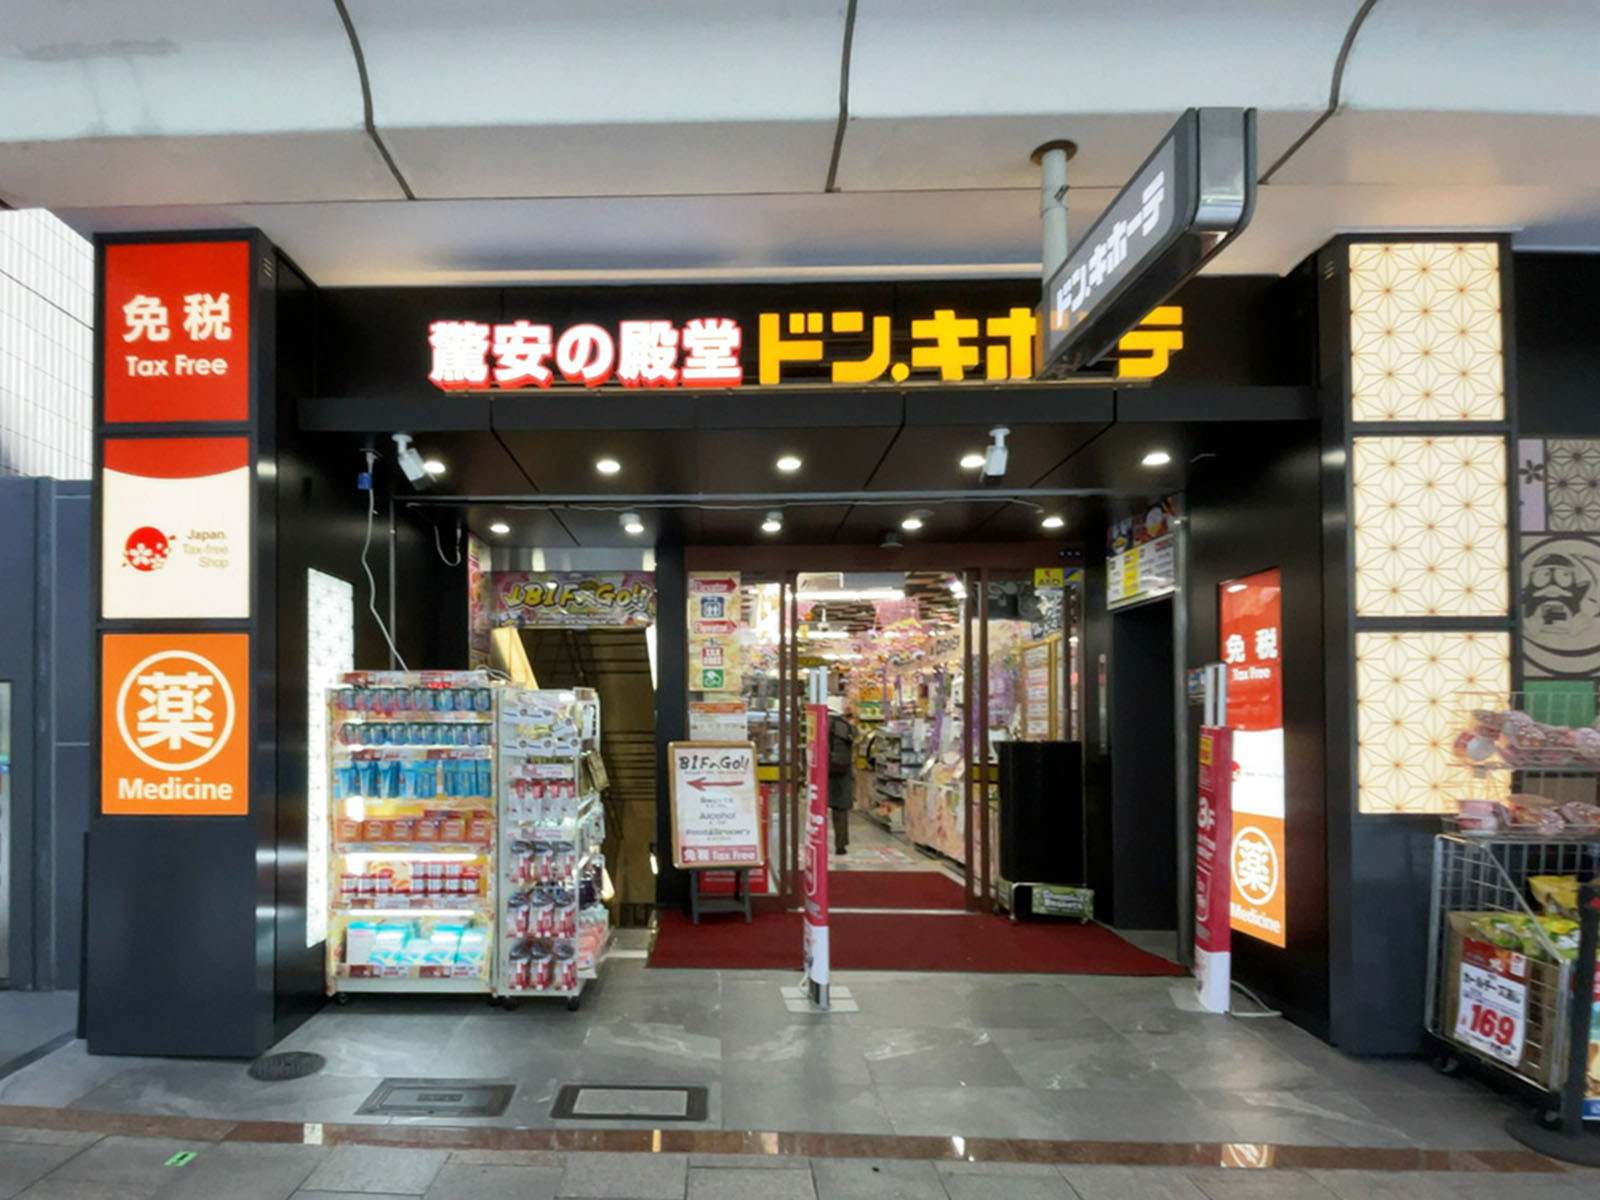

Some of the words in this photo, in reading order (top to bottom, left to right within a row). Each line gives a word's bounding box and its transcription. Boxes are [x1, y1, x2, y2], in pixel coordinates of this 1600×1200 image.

[122, 292, 232, 343] 免税
[125, 356, 169, 376] Tax
[175, 354, 228, 375] Free
[429, 319, 742, 389] 驚安の殿堂
[199, 556, 229, 568] Shop
[1226, 627, 1278, 664] 免税
[137, 672, 214, 750] 薬
[118, 776, 233, 800] Medicine
[1237, 839, 1271, 894] 薬
[1231, 902, 1281, 934] Medicine
[1470, 1004, 1515, 1046] 169
